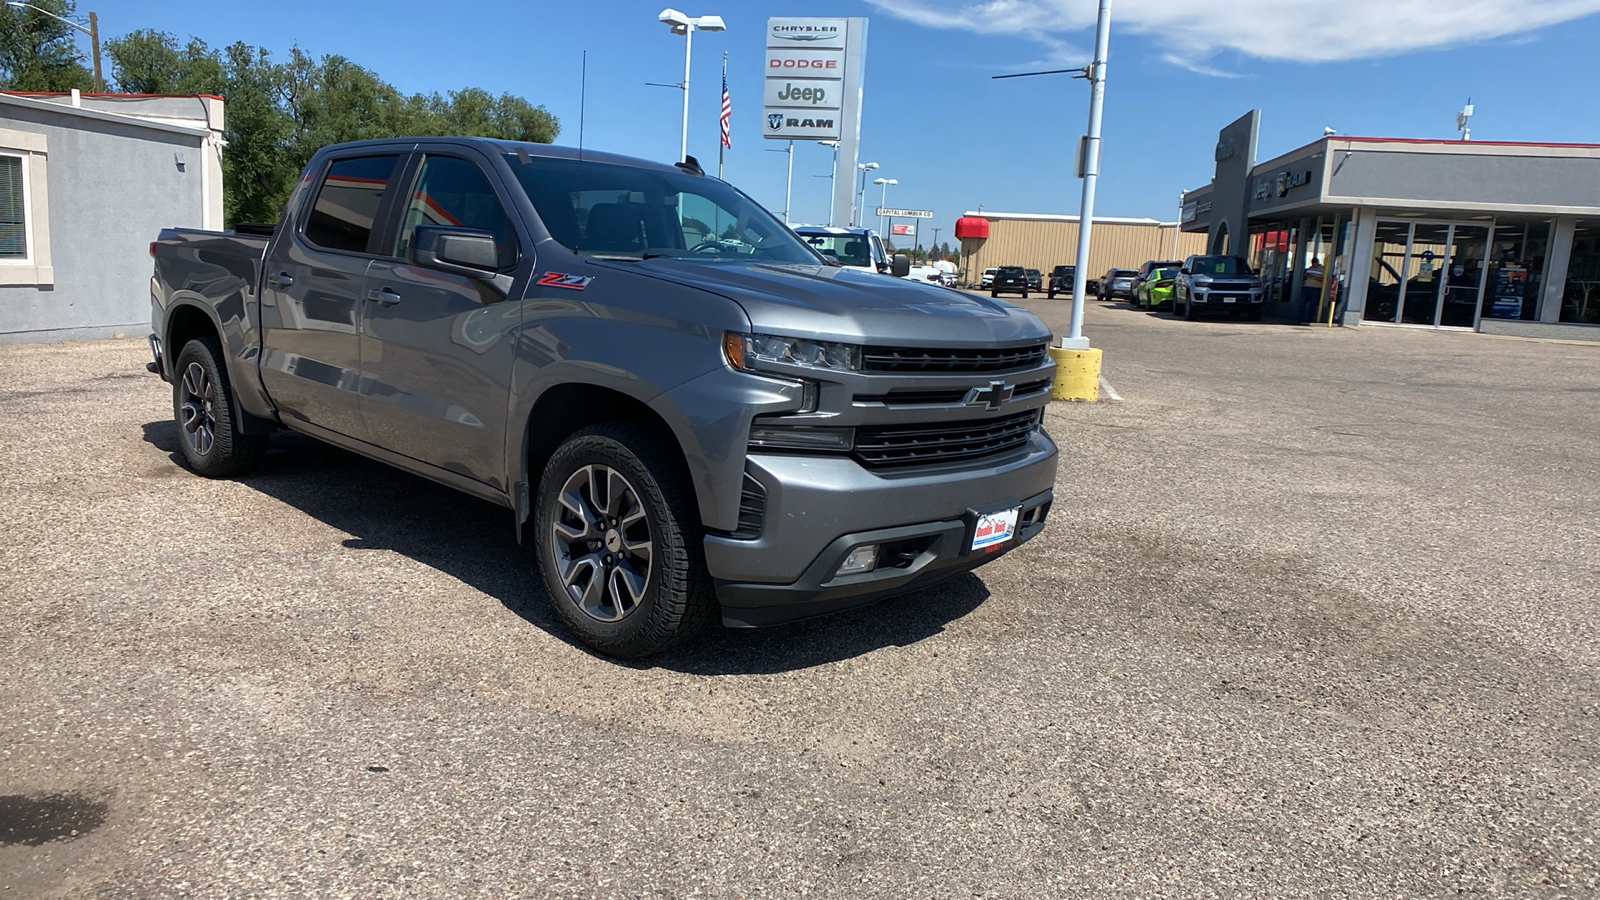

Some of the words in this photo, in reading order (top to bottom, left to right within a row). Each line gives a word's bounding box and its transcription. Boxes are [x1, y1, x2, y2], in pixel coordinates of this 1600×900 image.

[770, 59, 837, 68] DODGE
[778, 83, 825, 104] Jeep
[786, 119, 833, 128] RAM
[536, 271, 593, 290] Z71
